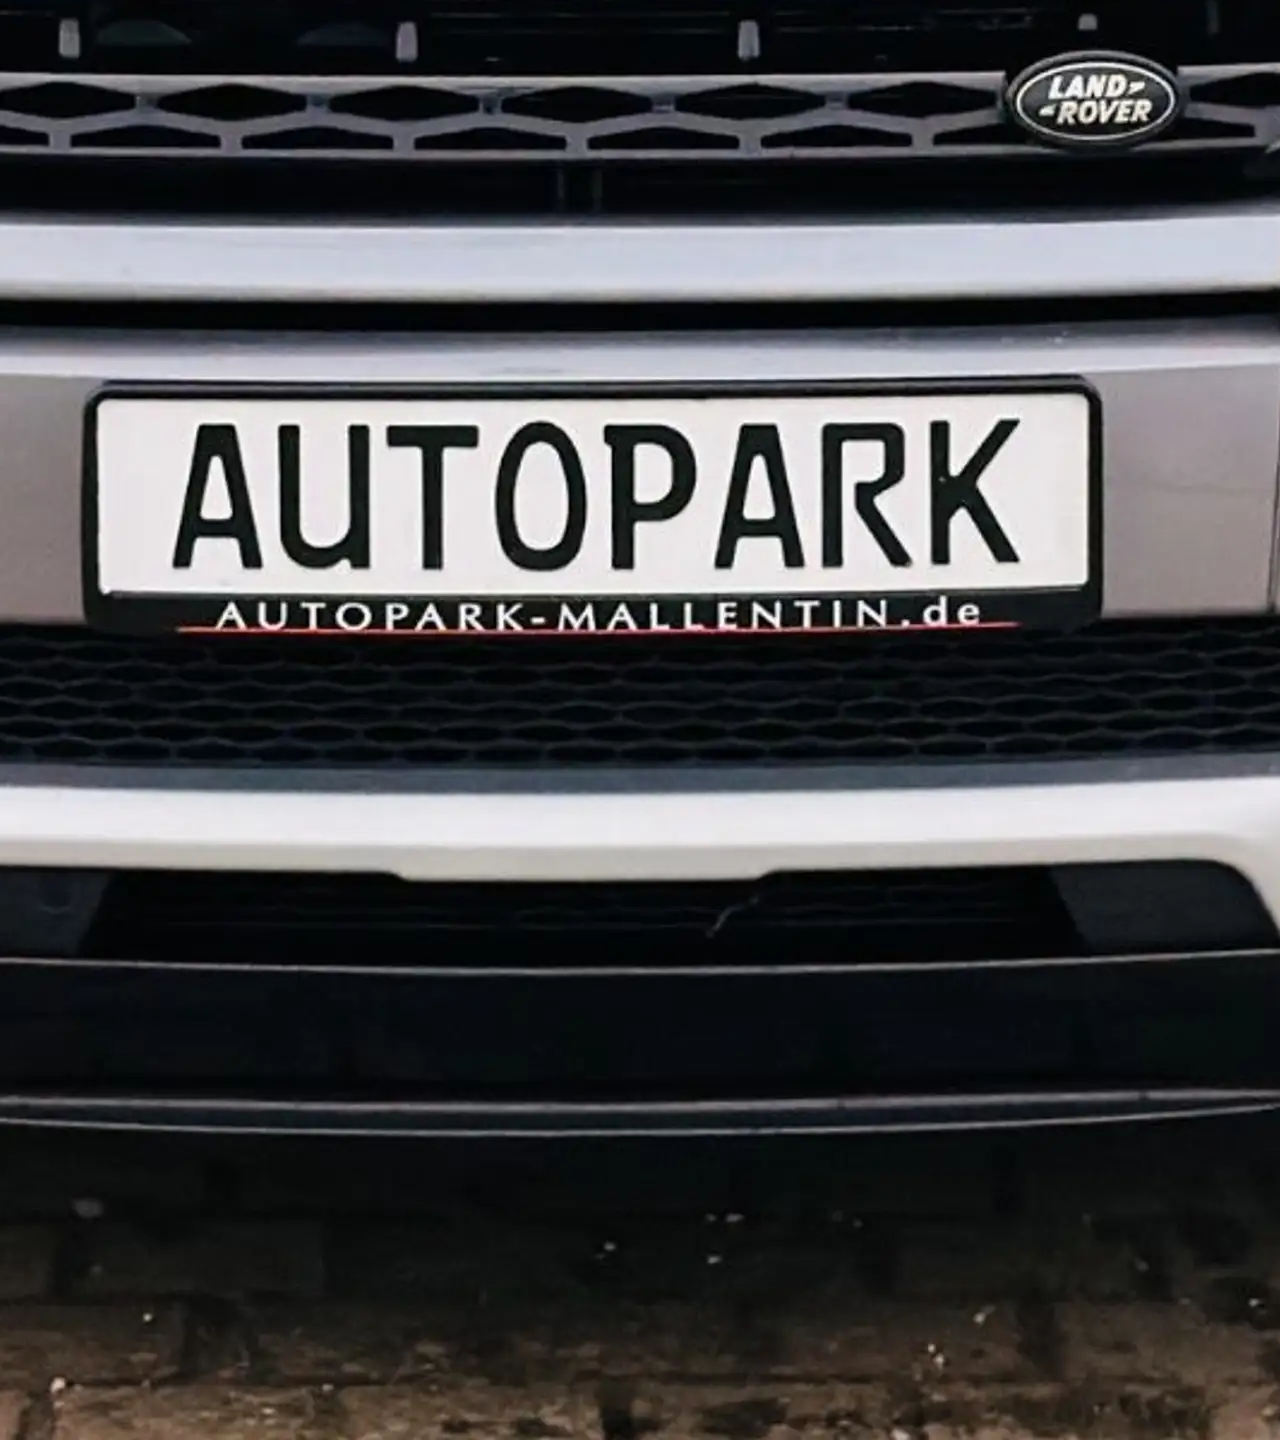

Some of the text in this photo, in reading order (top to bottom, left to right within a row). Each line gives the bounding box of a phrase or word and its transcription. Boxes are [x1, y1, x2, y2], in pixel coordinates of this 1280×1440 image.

[1047, 73, 1129, 100] LAND
[1055, 98, 1153, 126] ROVER
[170, 417, 1022, 572] AUTOPARK
[215, 595, 983, 632] AUTOPARK-MALLENTIN.de
